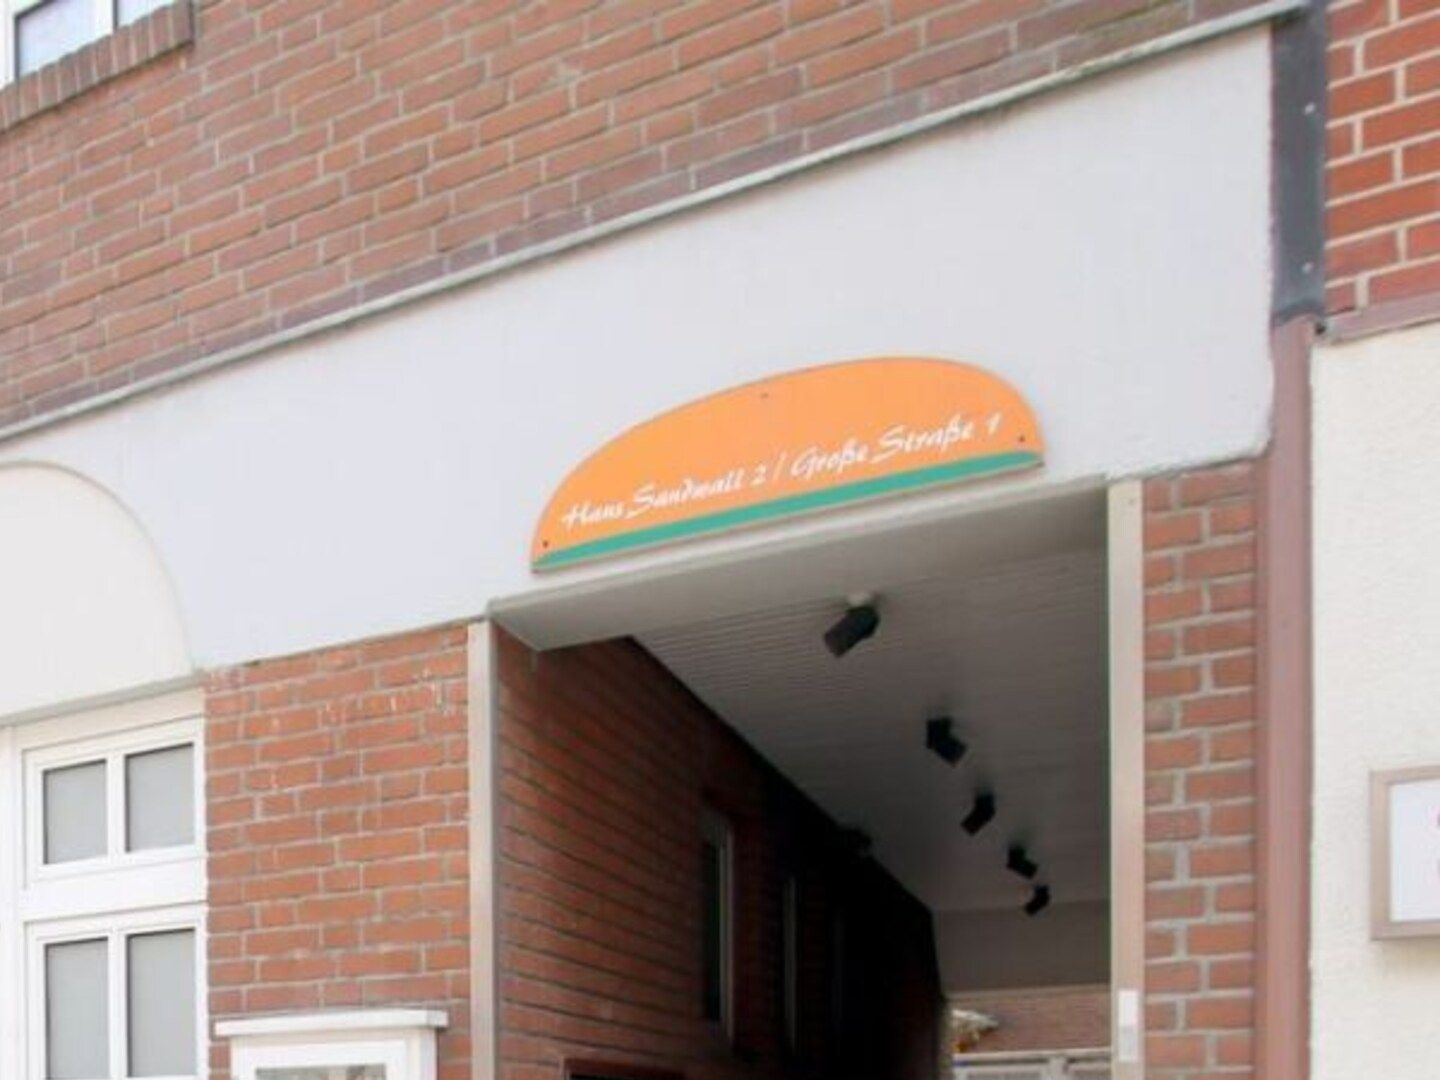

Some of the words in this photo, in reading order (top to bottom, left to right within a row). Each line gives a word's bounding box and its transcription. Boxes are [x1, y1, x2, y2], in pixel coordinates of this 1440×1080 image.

[791, 436, 869, 480] Große
[870, 413, 974, 464] Straße
[987, 412, 1002, 437] 1
